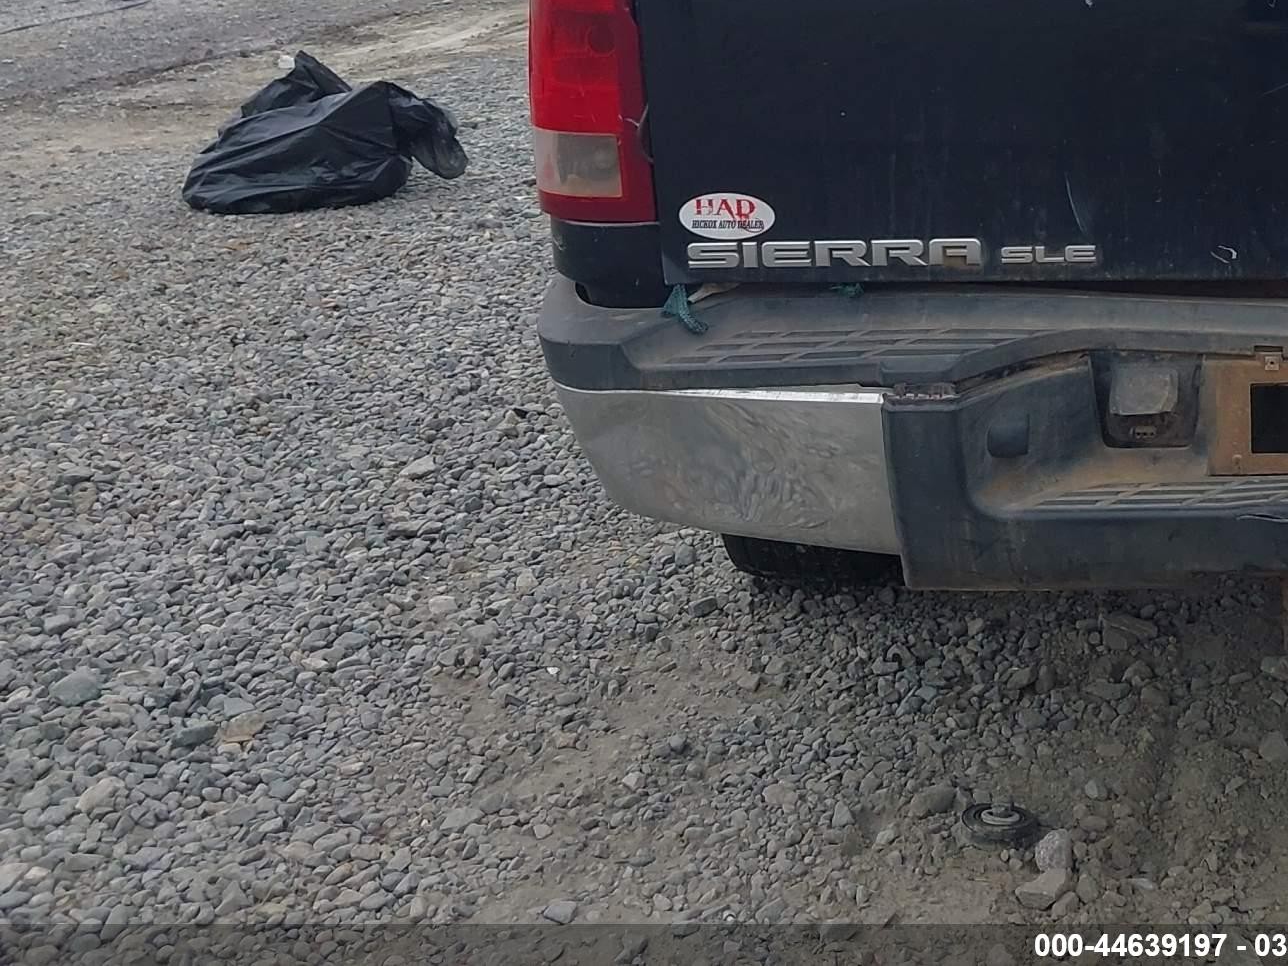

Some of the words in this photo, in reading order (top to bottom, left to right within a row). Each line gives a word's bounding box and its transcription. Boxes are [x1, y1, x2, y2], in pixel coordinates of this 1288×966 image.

[718, 219, 736, 229] AUTO
[687, 237, 982, 269] SIERRA
[1001, 244, 1096, 264] SLE
